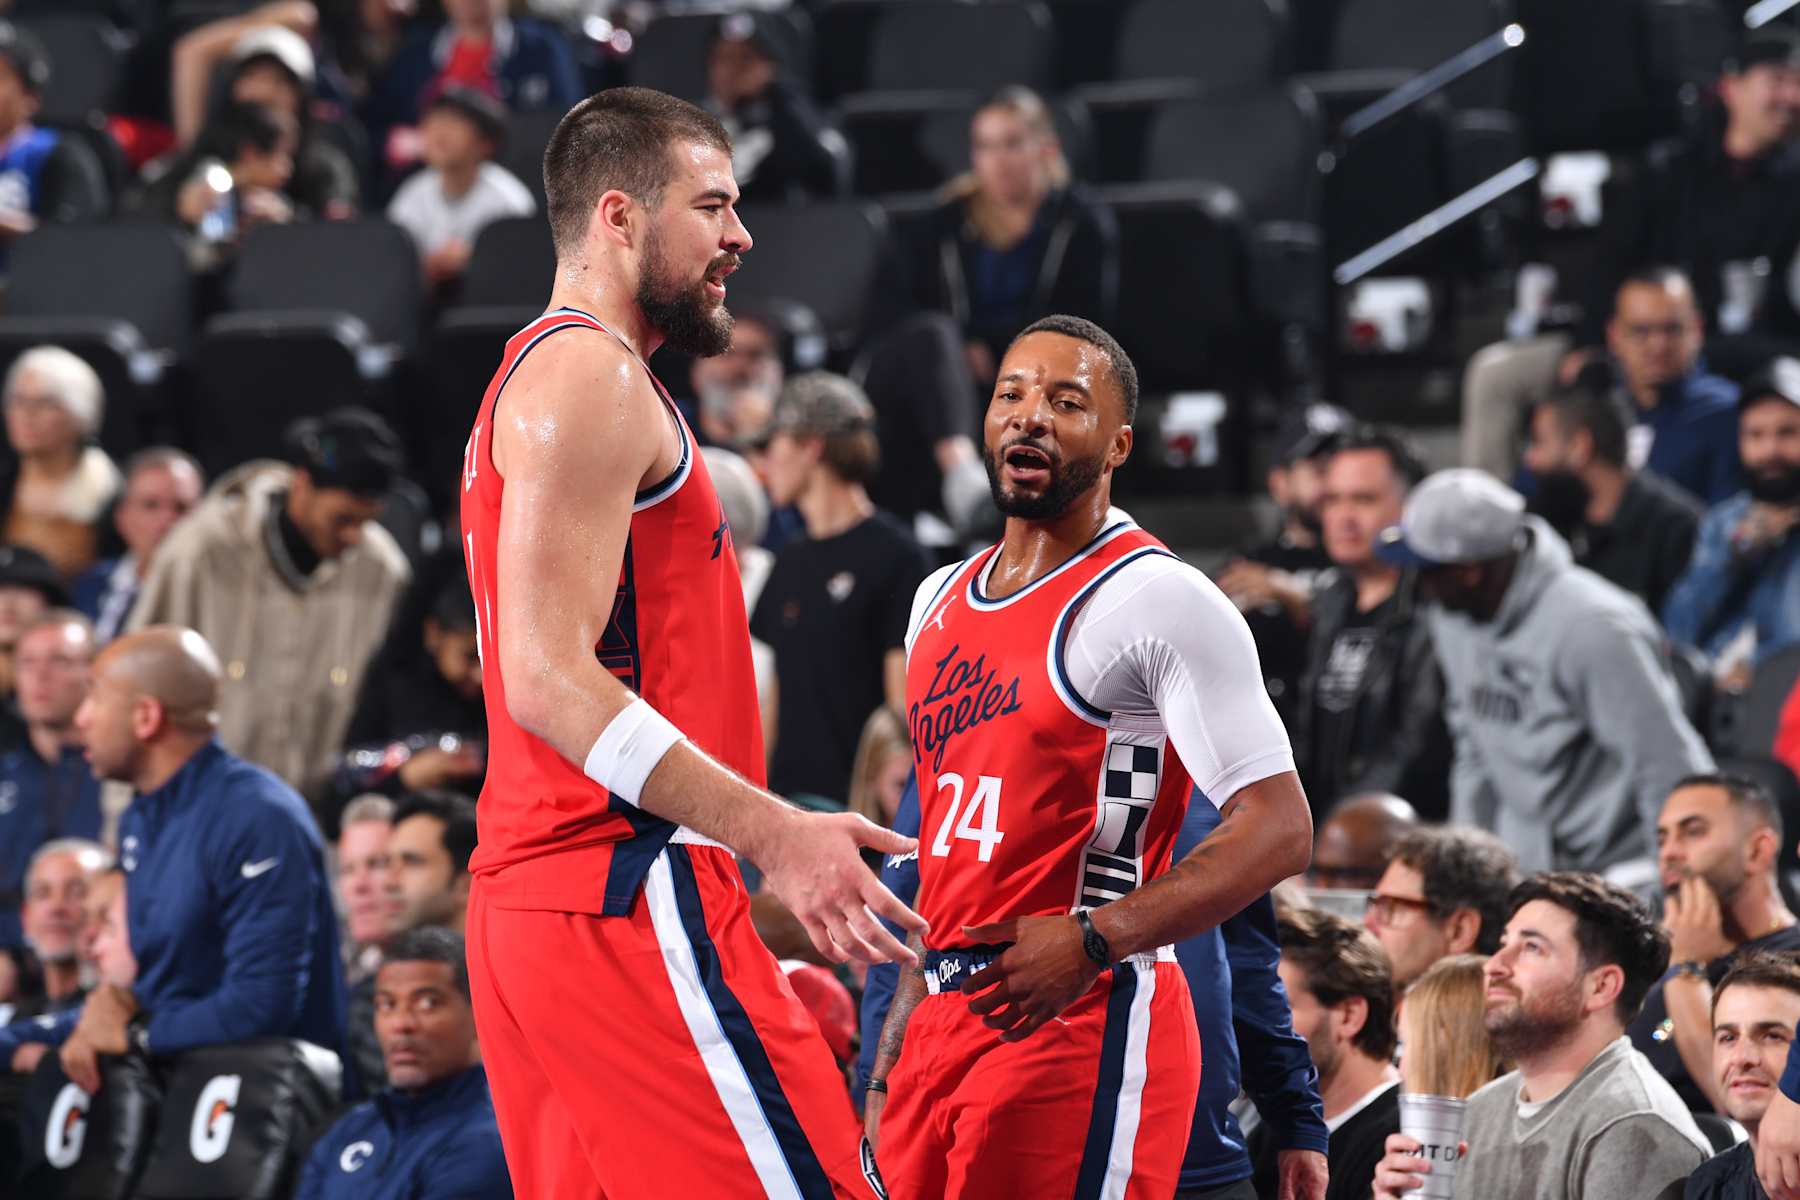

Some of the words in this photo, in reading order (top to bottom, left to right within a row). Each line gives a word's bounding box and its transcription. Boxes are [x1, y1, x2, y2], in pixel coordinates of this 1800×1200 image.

[923, 643, 985, 706] Los
[909, 669, 1023, 774] Angeles
[931, 772, 1005, 863] 24
[939, 958, 961, 984] Clips
[44, 1082, 91, 1169] G
[189, 1074, 241, 1164] G
